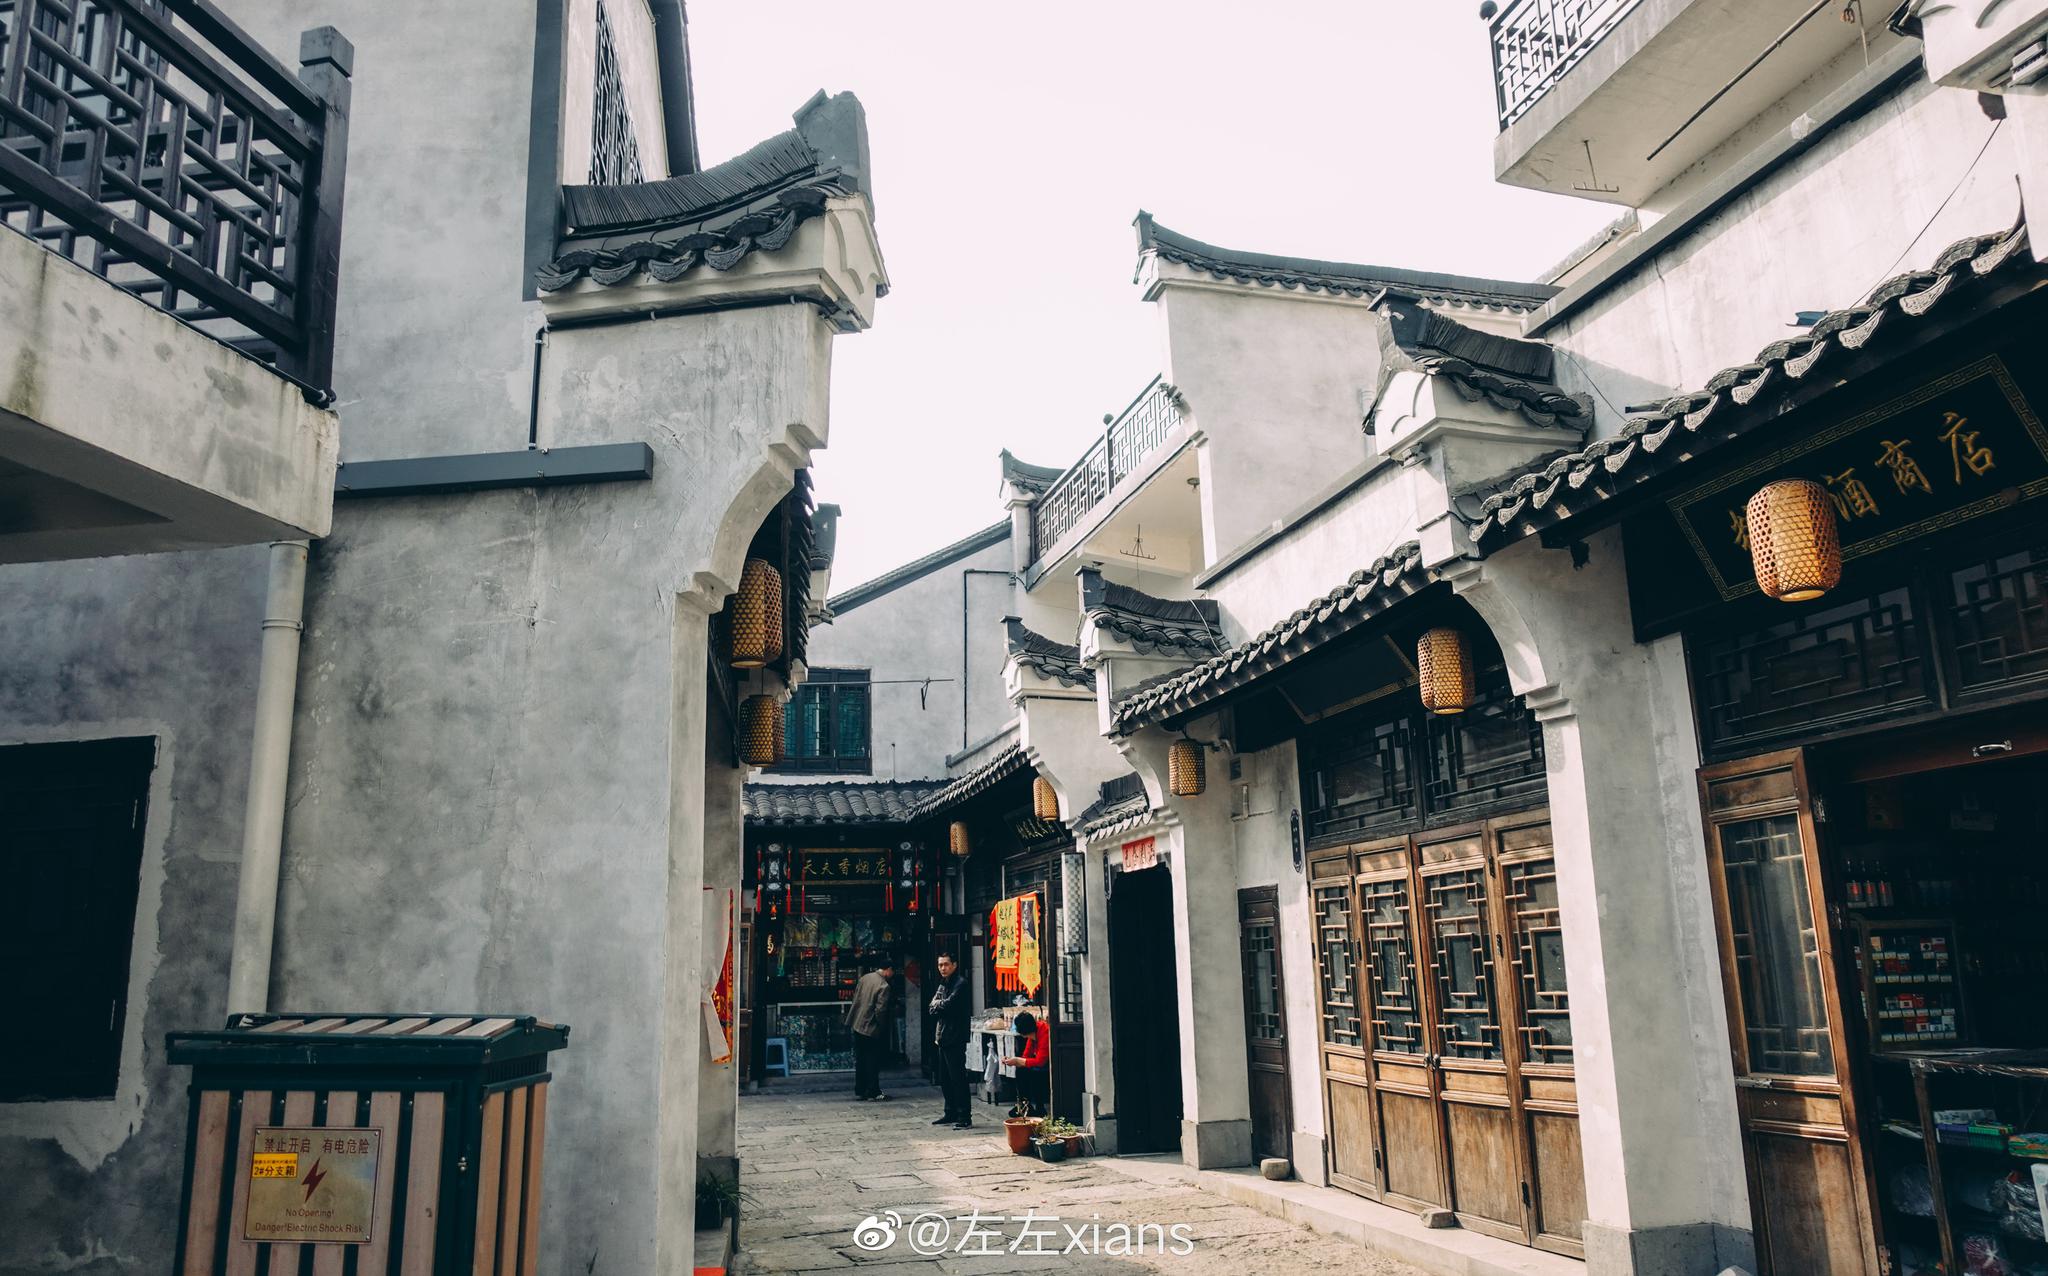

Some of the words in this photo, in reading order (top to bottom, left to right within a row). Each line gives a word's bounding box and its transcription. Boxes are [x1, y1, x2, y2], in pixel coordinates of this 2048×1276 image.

[264, 1137, 311, 1153] 禁止开启
[322, 1138, 370, 1155] 有电危险
[254, 1166, 296, 1177] 2#分支箱
[285, 1208, 297, 1217] No
[318, 1222, 343, 1232] Shock
[345, 1222, 363, 1232] Risk
